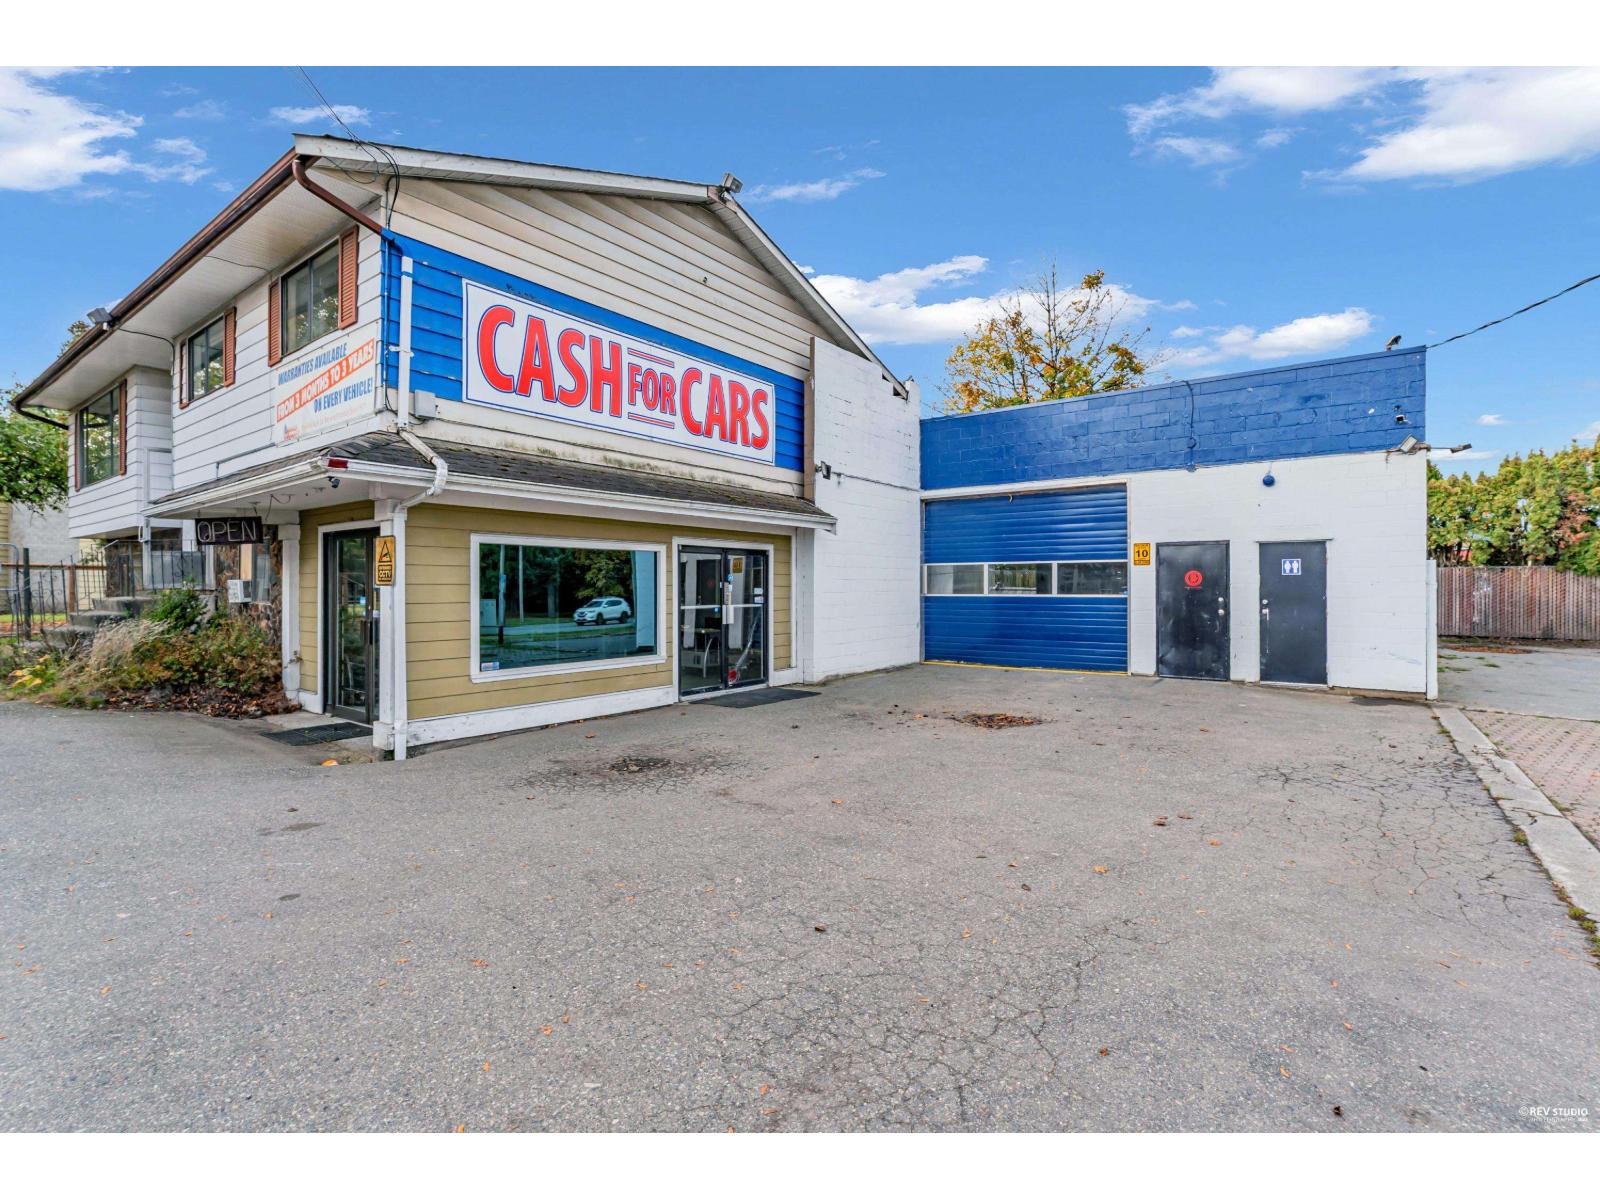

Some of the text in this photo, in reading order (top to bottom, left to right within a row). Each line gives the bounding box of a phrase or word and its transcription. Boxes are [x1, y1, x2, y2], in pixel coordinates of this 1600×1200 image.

[278, 342, 348, 386] WARRANTIES AVAILABLE
[301, 373, 330, 405] MONTHS
[330, 366, 341, 386] TO
[341, 361, 348, 381] 3
[349, 342, 374, 373] YEARS
[477, 304, 769, 450] CASH FOR CARS
[314, 377, 373, 413] ON EVERY VEHICLE!
[197, 520, 257, 542] OPEN
[1135, 549, 1149, 558] 10
[378, 570, 392, 578] CCTV
